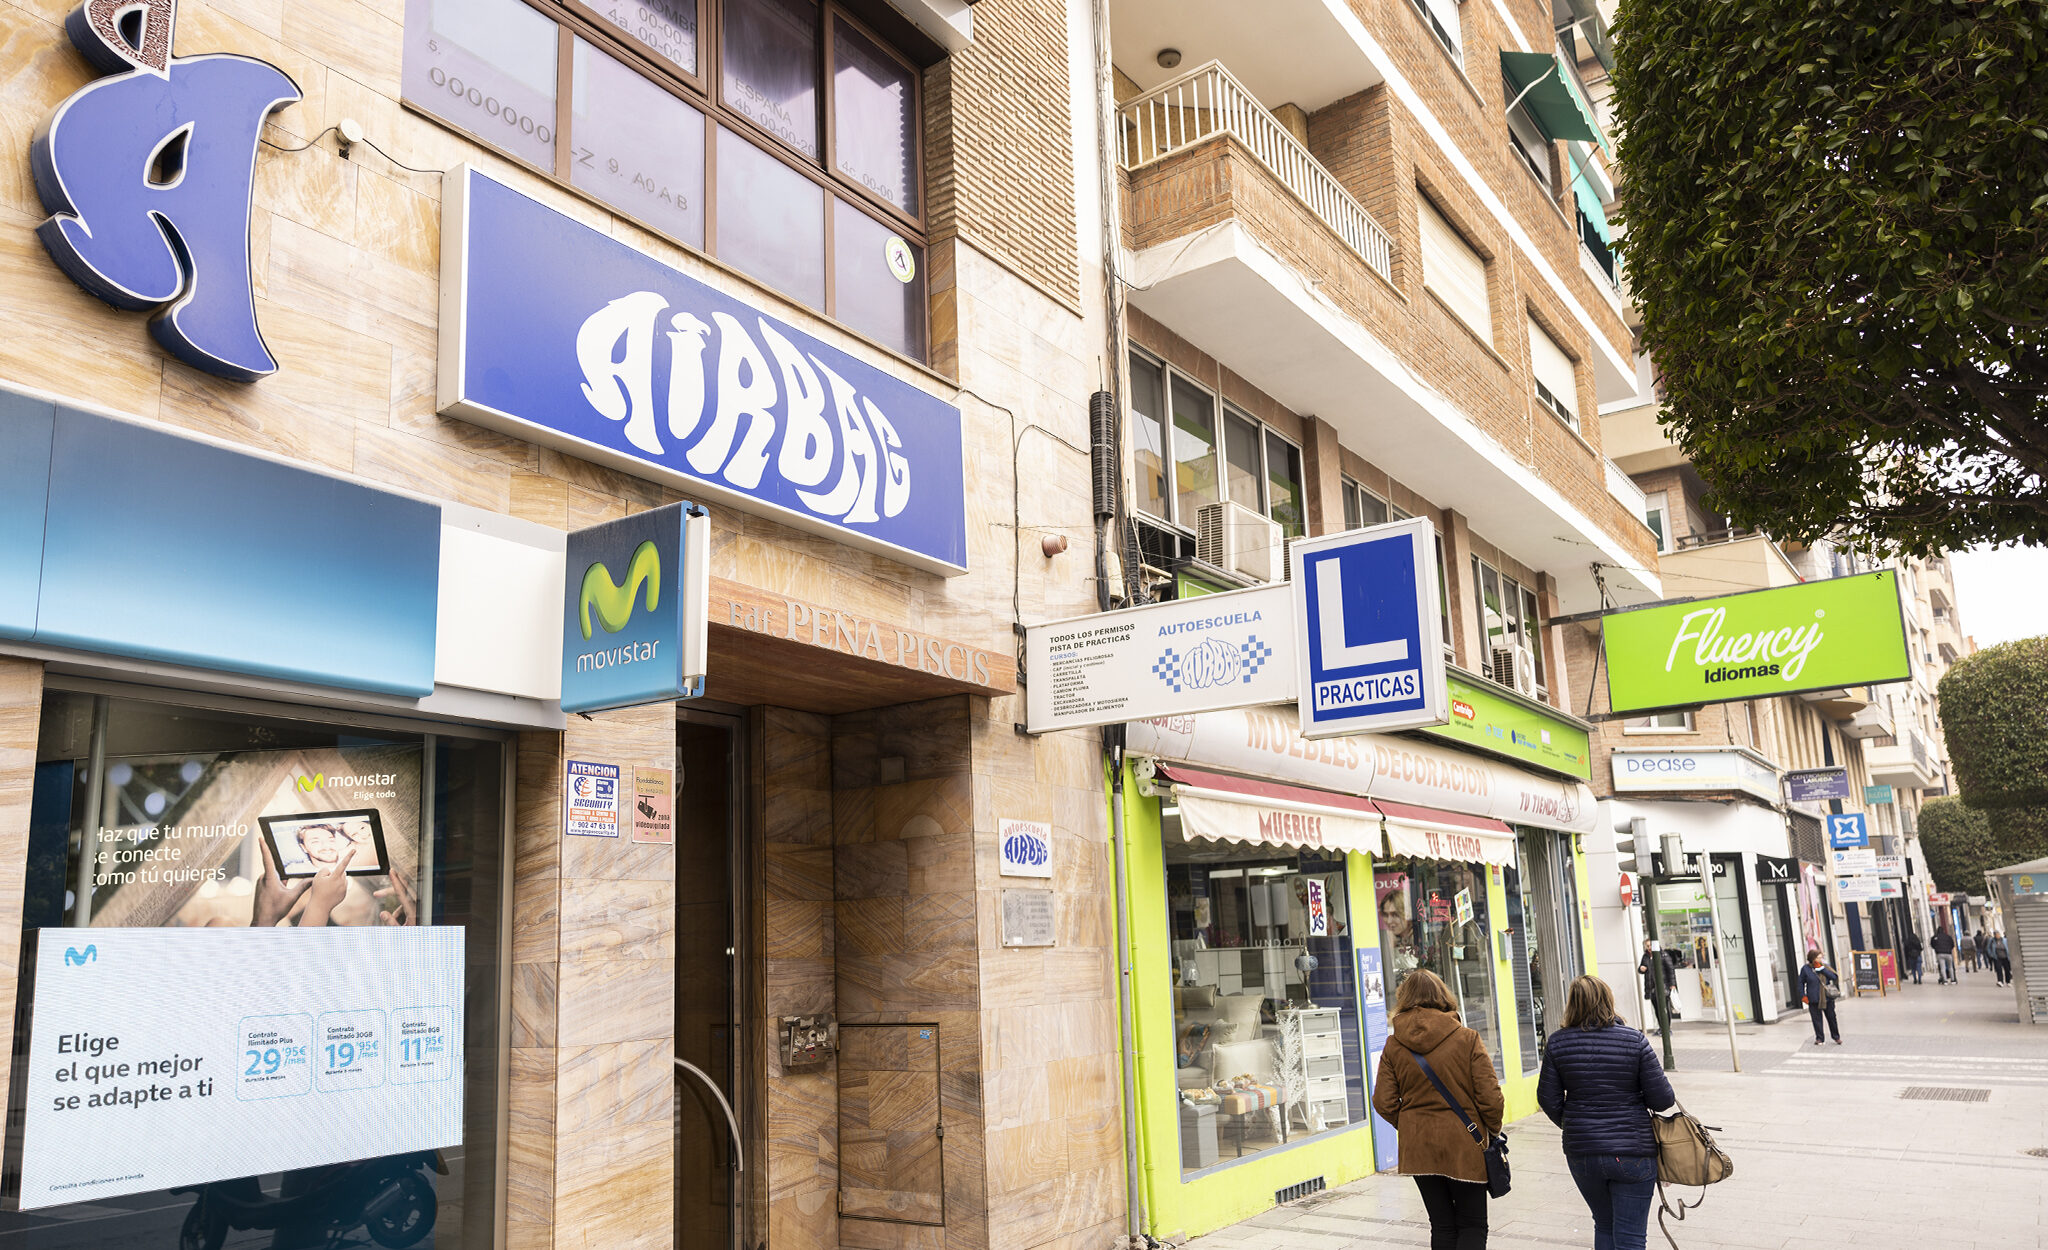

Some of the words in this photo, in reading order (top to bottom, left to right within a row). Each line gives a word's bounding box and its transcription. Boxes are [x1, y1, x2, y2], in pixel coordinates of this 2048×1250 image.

[735, 78, 793, 126] ESPAÑA
[576, 291, 911, 524] AIRBAG
[1158, 610, 1262, 637] AUTOESCUELA
[1316, 557, 1409, 671] L
[728, 600, 774, 636] Edf.
[784, 600, 887, 663] PEÑA
[893, 629, 991, 686] PISCIS
[1050, 634, 1075, 643] TODOS
[1077, 630, 1092, 639] LOS
[1095, 624, 1135, 636] PERMISOS
[1050, 643, 1072, 652] PISTA
[1074, 641, 1084, 649] DE
[1086, 634, 1131, 647] PRACTICAS
[1665, 607, 1824, 682] Fluency
[576, 638, 660, 673] movistar
[1084, 653, 1114, 661] PELIGROSAS
[1181, 637, 1242, 689] AIRBAG
[1053, 674, 1086, 683] TRANSPALETA
[1053, 681, 1084, 689] PLATAFORMA
[1704, 664, 1781, 684] Idiomas
[1319, 674, 1415, 706] PRACTICAS
[1096, 703, 1124, 711] ALIMENTOS
[329, 773, 396, 788] movistar
[571, 763, 617, 778] ATENCION
[1373, 744, 1488, 797] DECORACION
[354, 790, 375, 801] Elige
[376, 790, 396, 799] todo
[574, 799, 613, 809] SECURITY
[1520, 792, 1530, 812] TU
[127, 827, 159, 845] que
[164, 825, 183, 840] tu
[186, 822, 248, 839] mundo
[1004, 823, 1047, 840] autoescuela
[1258, 811, 1322, 844] MUEBLES
[113, 847, 181, 863] conecte
[1004, 833, 1048, 865] AIRBAG
[1425, 832, 1440, 855] TU
[1446, 834, 1483, 859] TIENDA
[140, 867, 158, 883] tú
[163, 867, 226, 885] quieras
[58, 1033, 119, 1057] Elige
[325, 1042, 354, 1068] 19
[400, 1037, 421, 1061] 11
[55, 1062, 77, 1082] el
[85, 1062, 130, 1084] que
[137, 1054, 203, 1078] mejor
[245, 1048, 281, 1076] 29
[53, 1095, 80, 1111] se
[88, 1084, 172, 1109] adapte
[179, 1085, 192, 1099] a
[197, 1077, 213, 1097] ti
